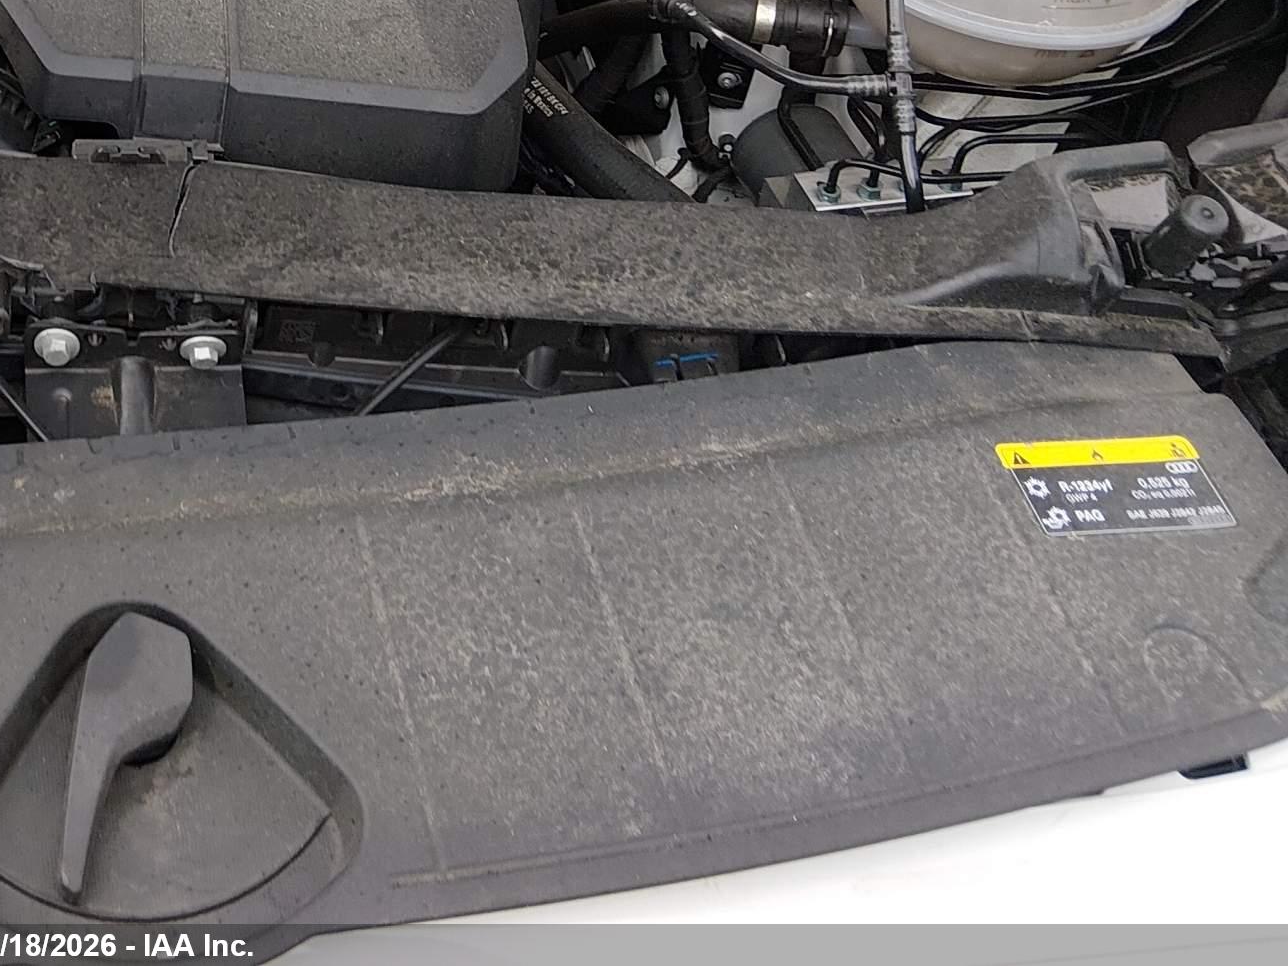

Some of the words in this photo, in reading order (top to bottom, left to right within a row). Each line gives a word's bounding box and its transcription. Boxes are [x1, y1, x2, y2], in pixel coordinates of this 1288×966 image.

[1057, 478, 1114, 494] R-1234yf
[1171, 475, 1191, 489] kg
[1074, 509, 1106, 523] PAG
